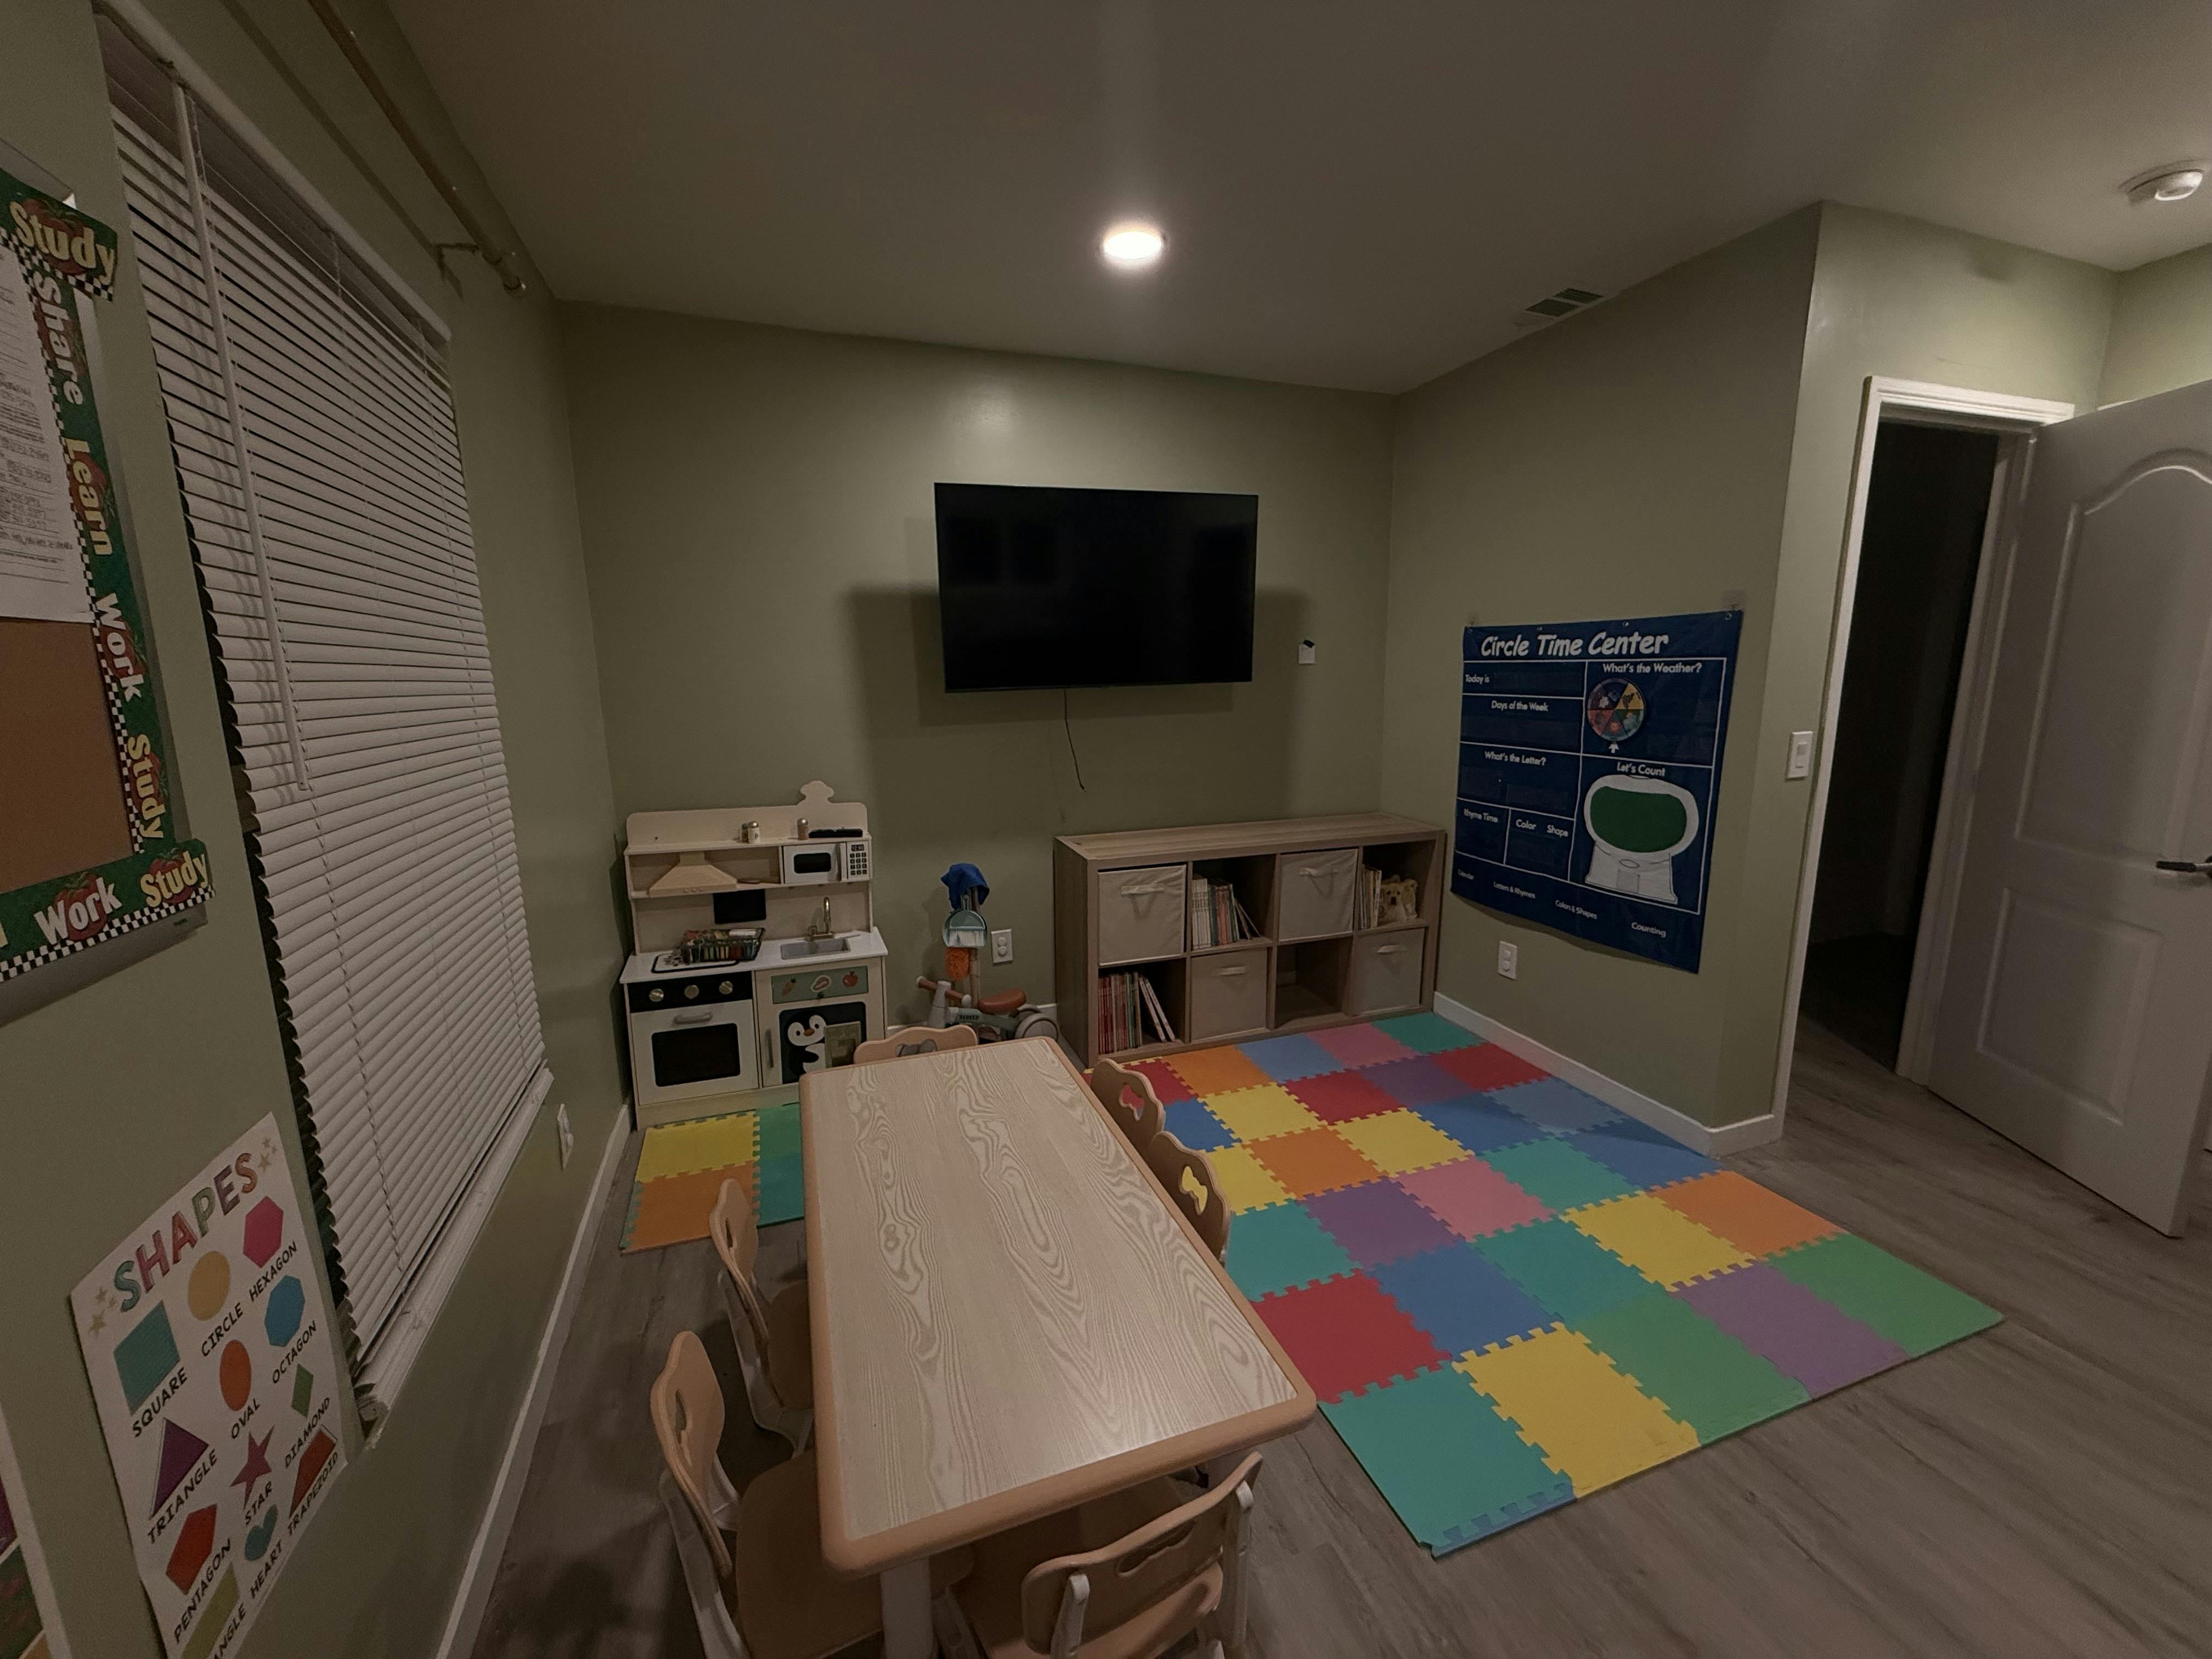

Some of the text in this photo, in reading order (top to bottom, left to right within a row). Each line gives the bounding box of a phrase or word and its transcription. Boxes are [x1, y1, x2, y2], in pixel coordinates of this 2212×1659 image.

[9, 200, 114, 286] Study
[33, 271, 164, 840] Share Learn Work Study
[1481, 631, 1669, 657] Circle Time Center
[1465, 674, 1483, 684] Today
[1602, 662, 1702, 674] What's the Weather?
[1491, 701, 1549, 712] Days of the Week
[1485, 751, 1547, 766] What's the Letter?
[1616, 762, 1666, 777] Let's Count
[1483, 812, 1498, 823] Time
[1515, 818, 1537, 831] Color
[1547, 824, 1568, 838] Shape
[33, 877, 122, 945] Work
[140, 850, 209, 908] Study
[1493, 881, 1509, 893] Letters
[1514, 886, 1536, 900] Rhymes
[1555, 900, 1571, 911] Colors
[1576, 906, 1598, 920] Shapes
[1631, 922, 1667, 938] Counting
[113, 1152, 258, 1313] SHAPES
[249, 1240, 298, 1302] HEXAGON
[201, 1302, 244, 1357] CIRCLE
[272, 1320, 318, 1384] OCTAGON
[132, 1365, 188, 1438] SQUARE
[230, 1398, 261, 1440] OVAL
[284, 1396, 331, 1470] DIAMOND
[148, 1449, 218, 1544] TRIANGLE
[245, 1481, 274, 1525] STAR
[287, 1451, 340, 1537] TRAPEZOID
[174, 1538, 231, 1643] PENTAGON
[250, 1539, 281, 1599] HEART
